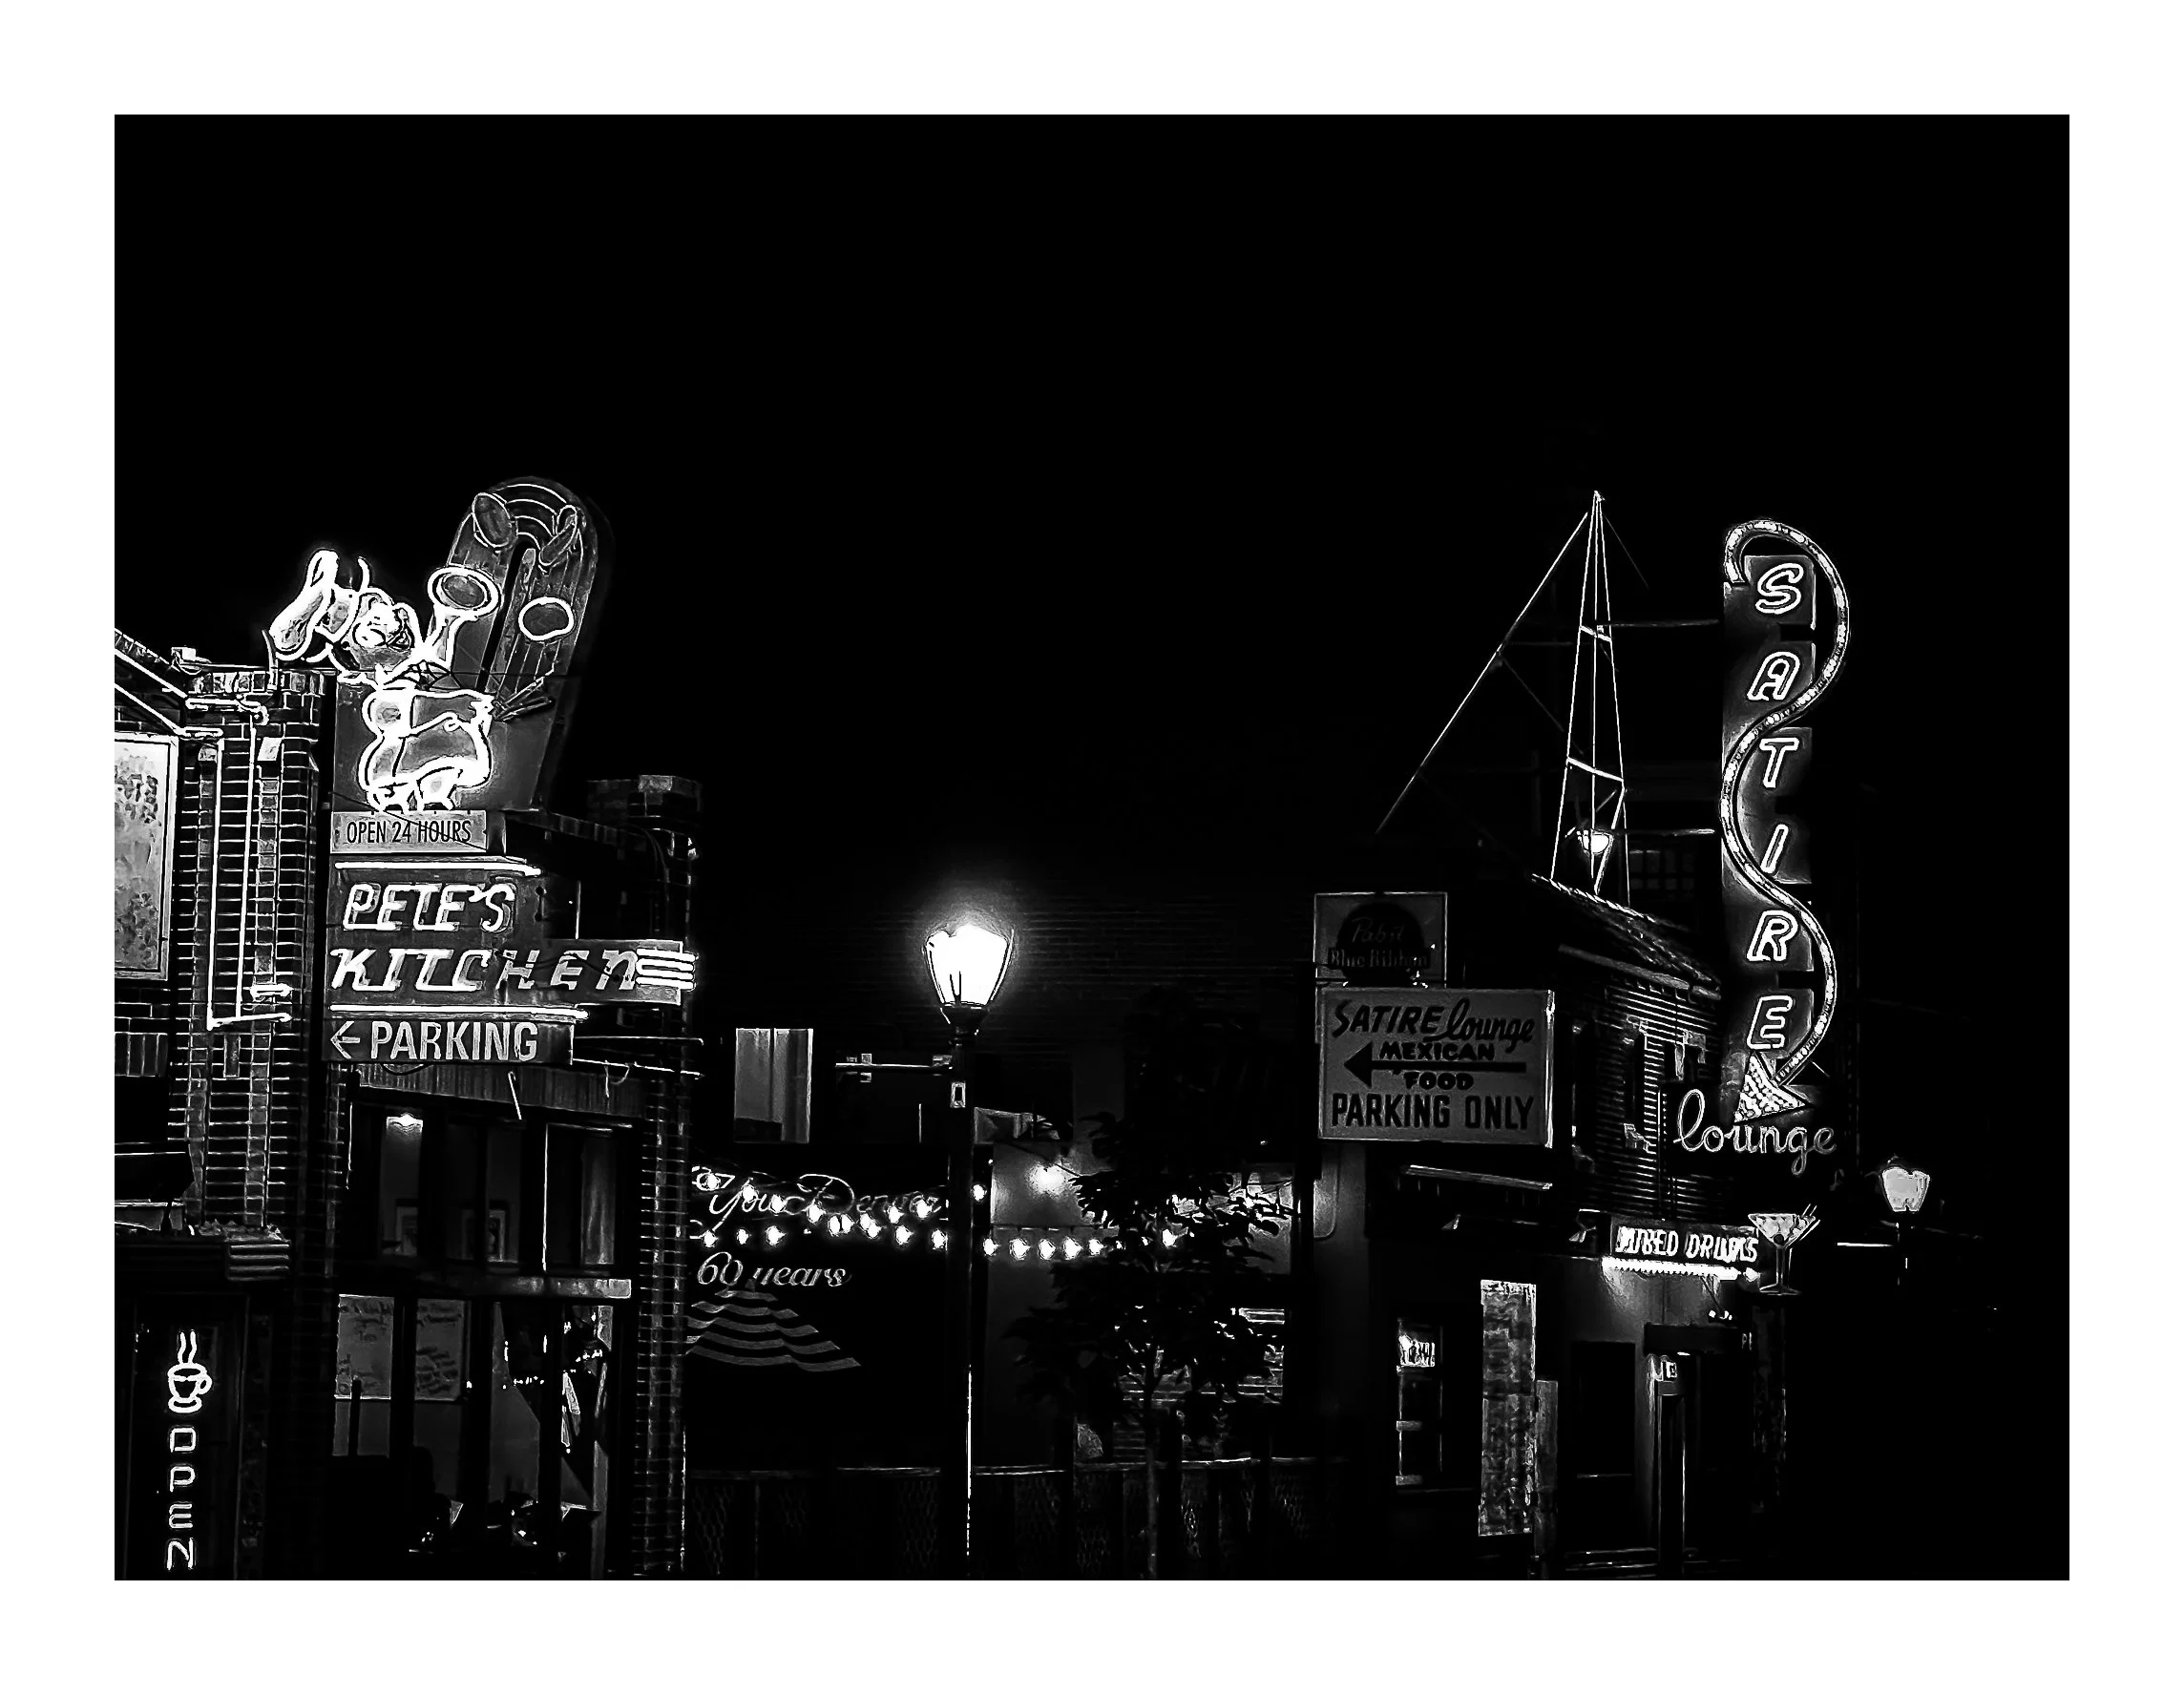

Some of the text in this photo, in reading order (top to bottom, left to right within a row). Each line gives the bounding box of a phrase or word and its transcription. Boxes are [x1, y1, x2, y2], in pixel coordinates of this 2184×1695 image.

[1746, 561, 1802, 1050] SATIRE
[346, 820, 472, 844] OPEN 24 HOURS
[343, 881, 516, 932] PETE'S
[1352, 916, 1405, 943] Pabst
[330, 948, 638, 992] KITCHEN
[1329, 947, 1429, 968] Blue Ribbon
[371, 1021, 539, 1061] PARKING
[1333, 998, 1535, 1052] SATIRE lounge
[1379, 1041, 1495, 1061] MEXICAN
[1404, 1071, 1474, 1090] FOOD
[1332, 1093, 1534, 1129] PARKING ONLY
[1672, 1088, 1838, 1179] lounge
[697, 1251, 853, 1289] 60 years
[165, 1425, 199, 1572] OPEN
